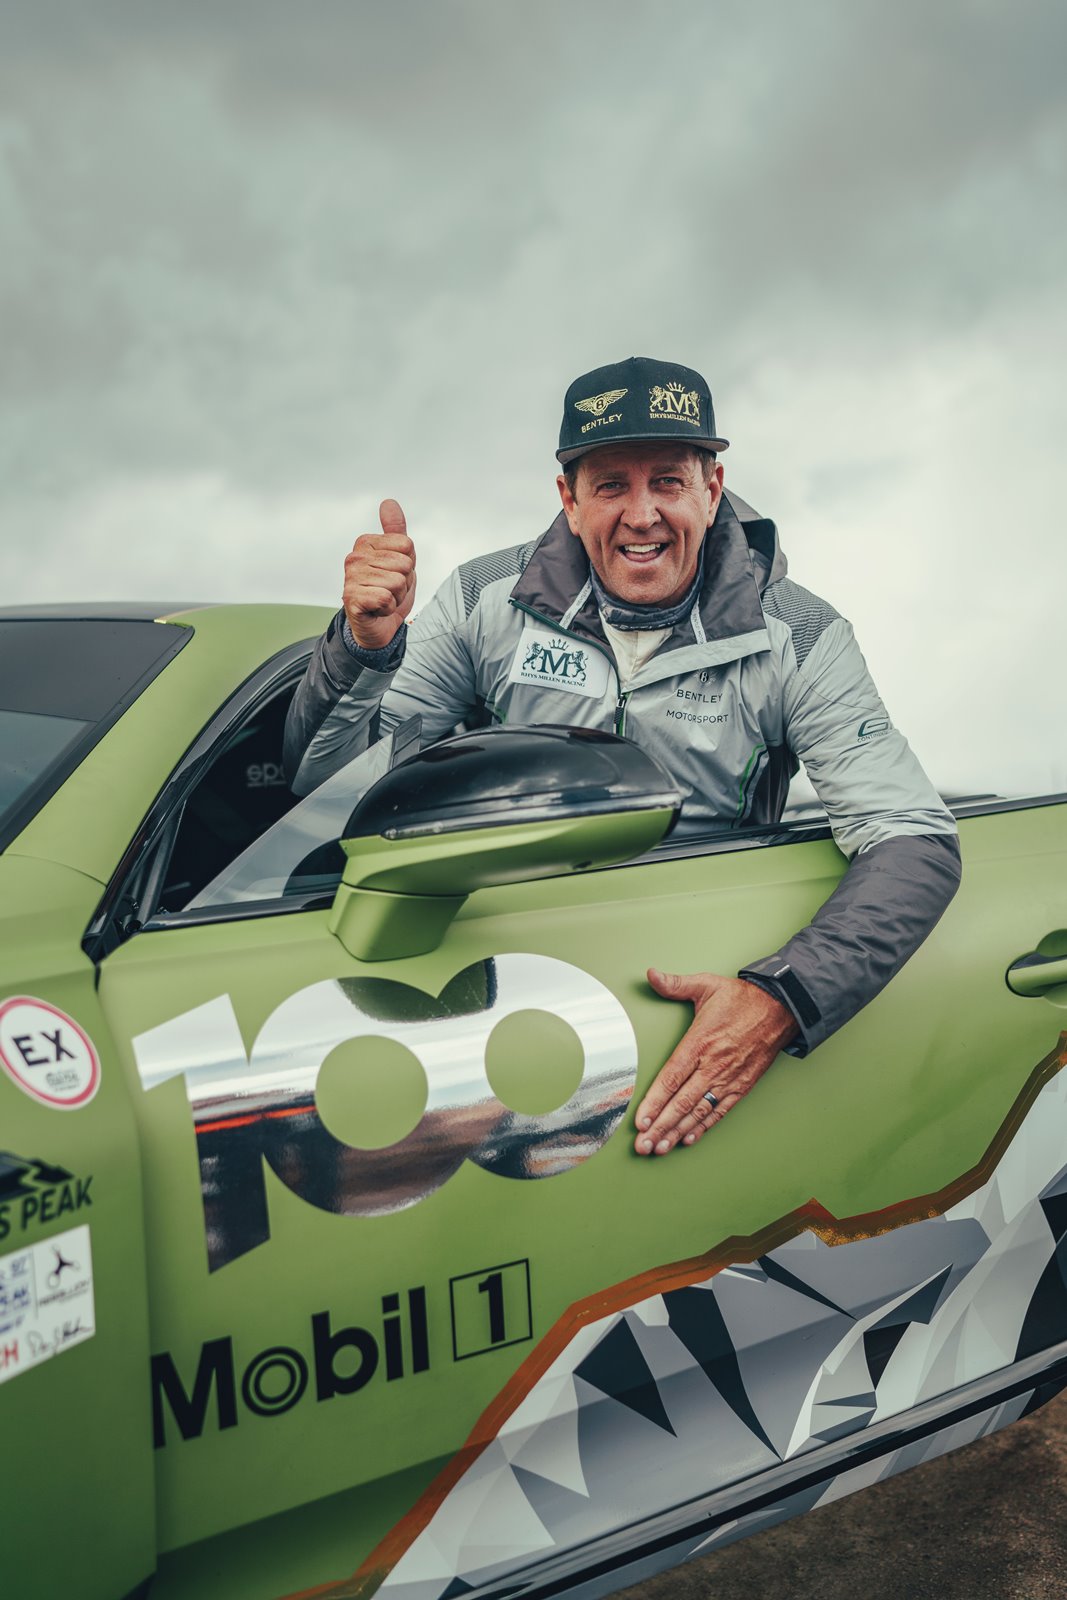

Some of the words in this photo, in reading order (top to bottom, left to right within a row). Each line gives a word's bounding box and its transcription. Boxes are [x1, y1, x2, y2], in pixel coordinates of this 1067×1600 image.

[581, 413, 623, 433] BENTLEY
[537, 648, 573, 678] M
[521, 671, 538, 679] RHYS
[538, 674, 561, 683] MILLEN
[561, 679, 586, 688] RACING
[676, 689, 723, 704] BENTLEY
[666, 709, 729, 724] MOTORSPORT
[12, 1030, 77, 1067] EX
[131, 952, 638, 1276] 100
[21, 1174, 94, 1231] PEAK
[150, 1286, 430, 1450] Mobil
[478, 1272, 506, 1345] 1
